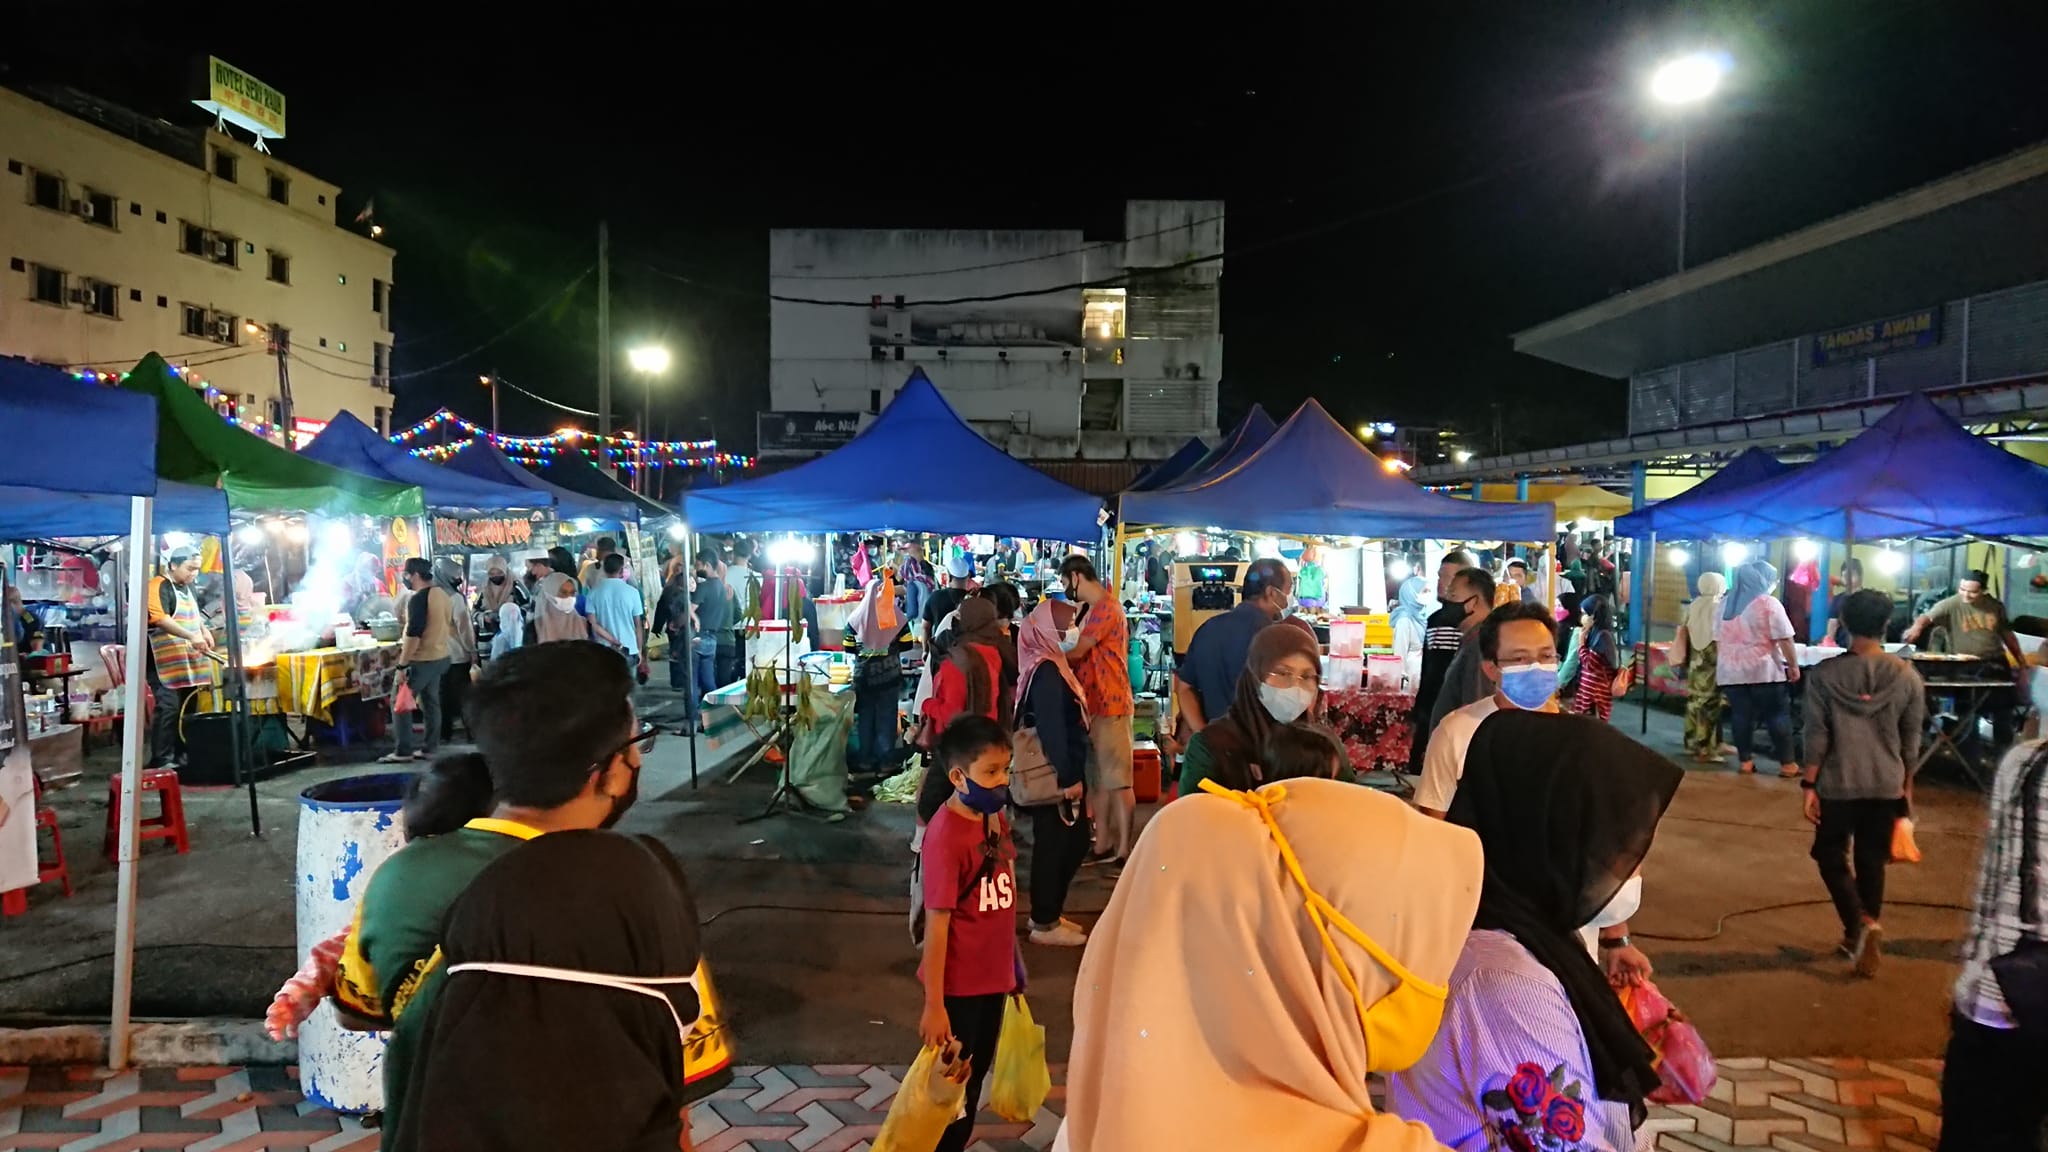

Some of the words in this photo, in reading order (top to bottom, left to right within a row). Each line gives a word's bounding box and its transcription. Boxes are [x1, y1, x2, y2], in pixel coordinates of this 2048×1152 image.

[216, 63, 244, 95] HOTEL
[1817, 326, 1875, 349] TANDAS
[1882, 312, 1931, 338] AWAM
[979, 872, 1013, 912] AS
